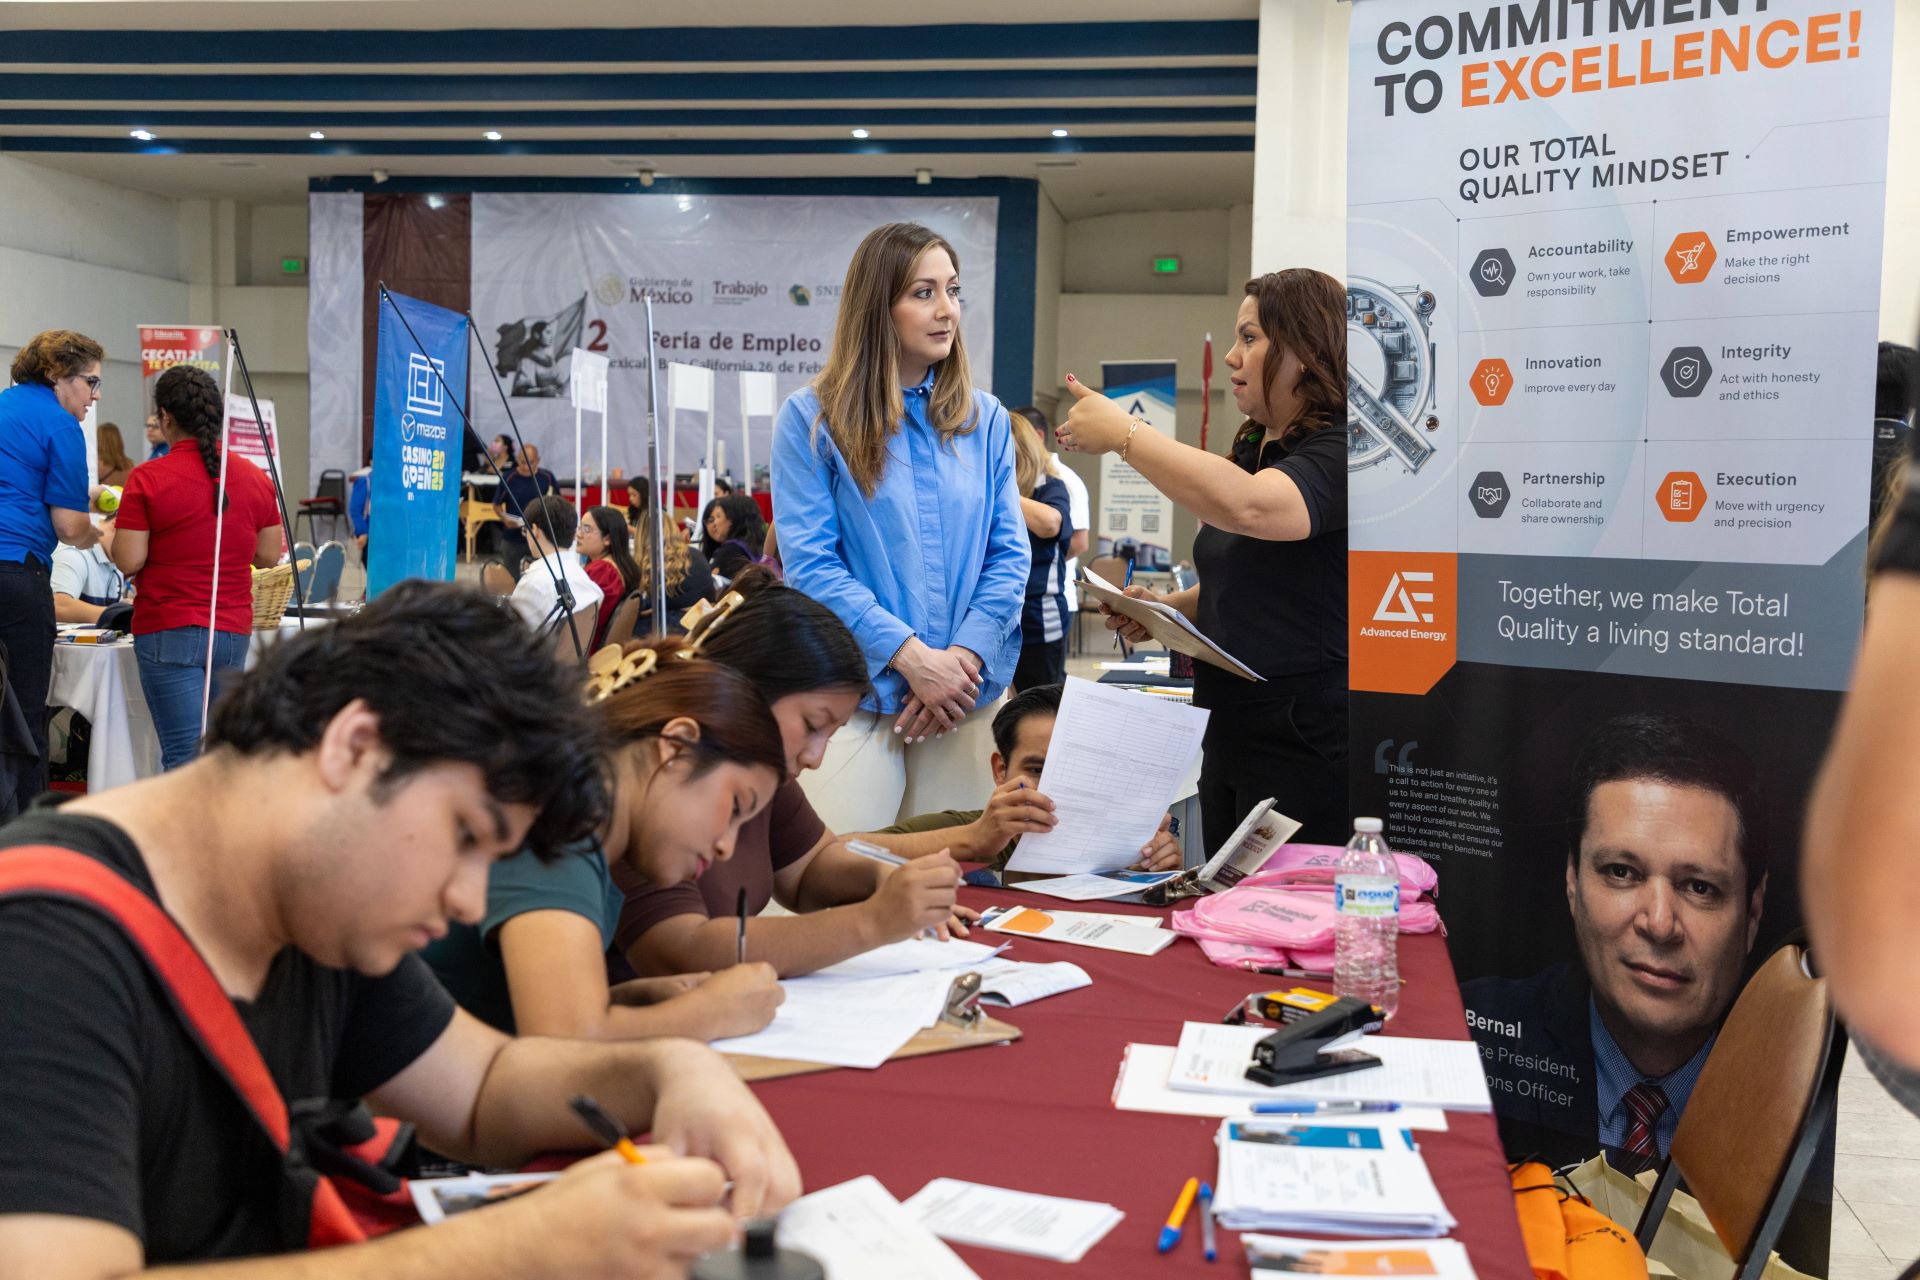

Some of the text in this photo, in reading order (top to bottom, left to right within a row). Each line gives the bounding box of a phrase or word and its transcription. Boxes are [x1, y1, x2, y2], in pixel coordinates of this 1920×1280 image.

[1375, 10, 1862, 117] TO EXCELLENCE!
[1459, 133, 1617, 171] OUR TOTAL
[1459, 151, 1730, 204] QUALITY MINDSET
[1726, 222, 1850, 244] Empowerment
[1528, 239, 1634, 258] Accountability
[1724, 254, 1810, 268] Make the right
[1527, 266, 1630, 282] Own your work, take
[1724, 274, 1781, 285] decisions
[712, 280, 768, 297] Trabajo
[1527, 284, 1597, 299] responsibility
[709, 332, 734, 350] de
[742, 333, 822, 356] Empleo
[1721, 344, 1792, 361] Integrity
[778, 360, 794, 373] de
[1525, 356, 1602, 370] Innovation
[1720, 372, 1820, 384] Act with honesty
[1524, 382, 1616, 394] Improve every day
[1719, 389, 1780, 401] and ethics
[402, 445, 432, 466] CASINO
[1522, 472, 1605, 488] Partnership
[1716, 472, 1797, 486] Execution
[1521, 498, 1602, 509] Collaborate and
[1715, 500, 1825, 514] Move with urgency
[1521, 514, 1604, 526] share ownership
[1714, 518, 1792, 530] and precision
[1498, 580, 1789, 617] Together, we make Total
[1360, 626, 1409, 638] Advanced
[1498, 614, 1804, 657] Quality a living standard!
[1389, 764, 1405, 773] This
[1416, 767, 1428, 775] not
[1430, 768, 1444, 777] just
[1421, 780, 1443, 789] action
[1445, 781, 1455, 790] for
[1456, 784, 1475, 795] every
[1476, 788, 1489, 796] one
[1490, 789, 1498, 797] of
[1410, 790, 1422, 798] live
[1425, 792, 1438, 800] and
[1441, 794, 1466, 805] breathe
[1468, 798, 1491, 810] quality
[1492, 801, 1498, 809] in
[1389, 801, 1410, 810] every
[1412, 802, 1437, 812] aspect
[1439, 804, 1446, 813] of
[1480, 811, 1491, 821] We
[1389, 812, 1402, 820] will
[1404, 813, 1420, 822] hold
[1422, 816, 1456, 827] ourselves
[1389, 824, 1406, 832] lead
[1408, 825, 1417, 835] by
[1452, 832, 1465, 841] and
[1467, 835, 1490, 845] ensure
[1491, 840, 1503, 848] our
[1389, 836, 1493, 858] standards are the benchmark
[1466, 1009, 1522, 1039] Bernal
[1498, 1047, 1580, 1084] President,
[1517, 1079, 1574, 1108] Officer
